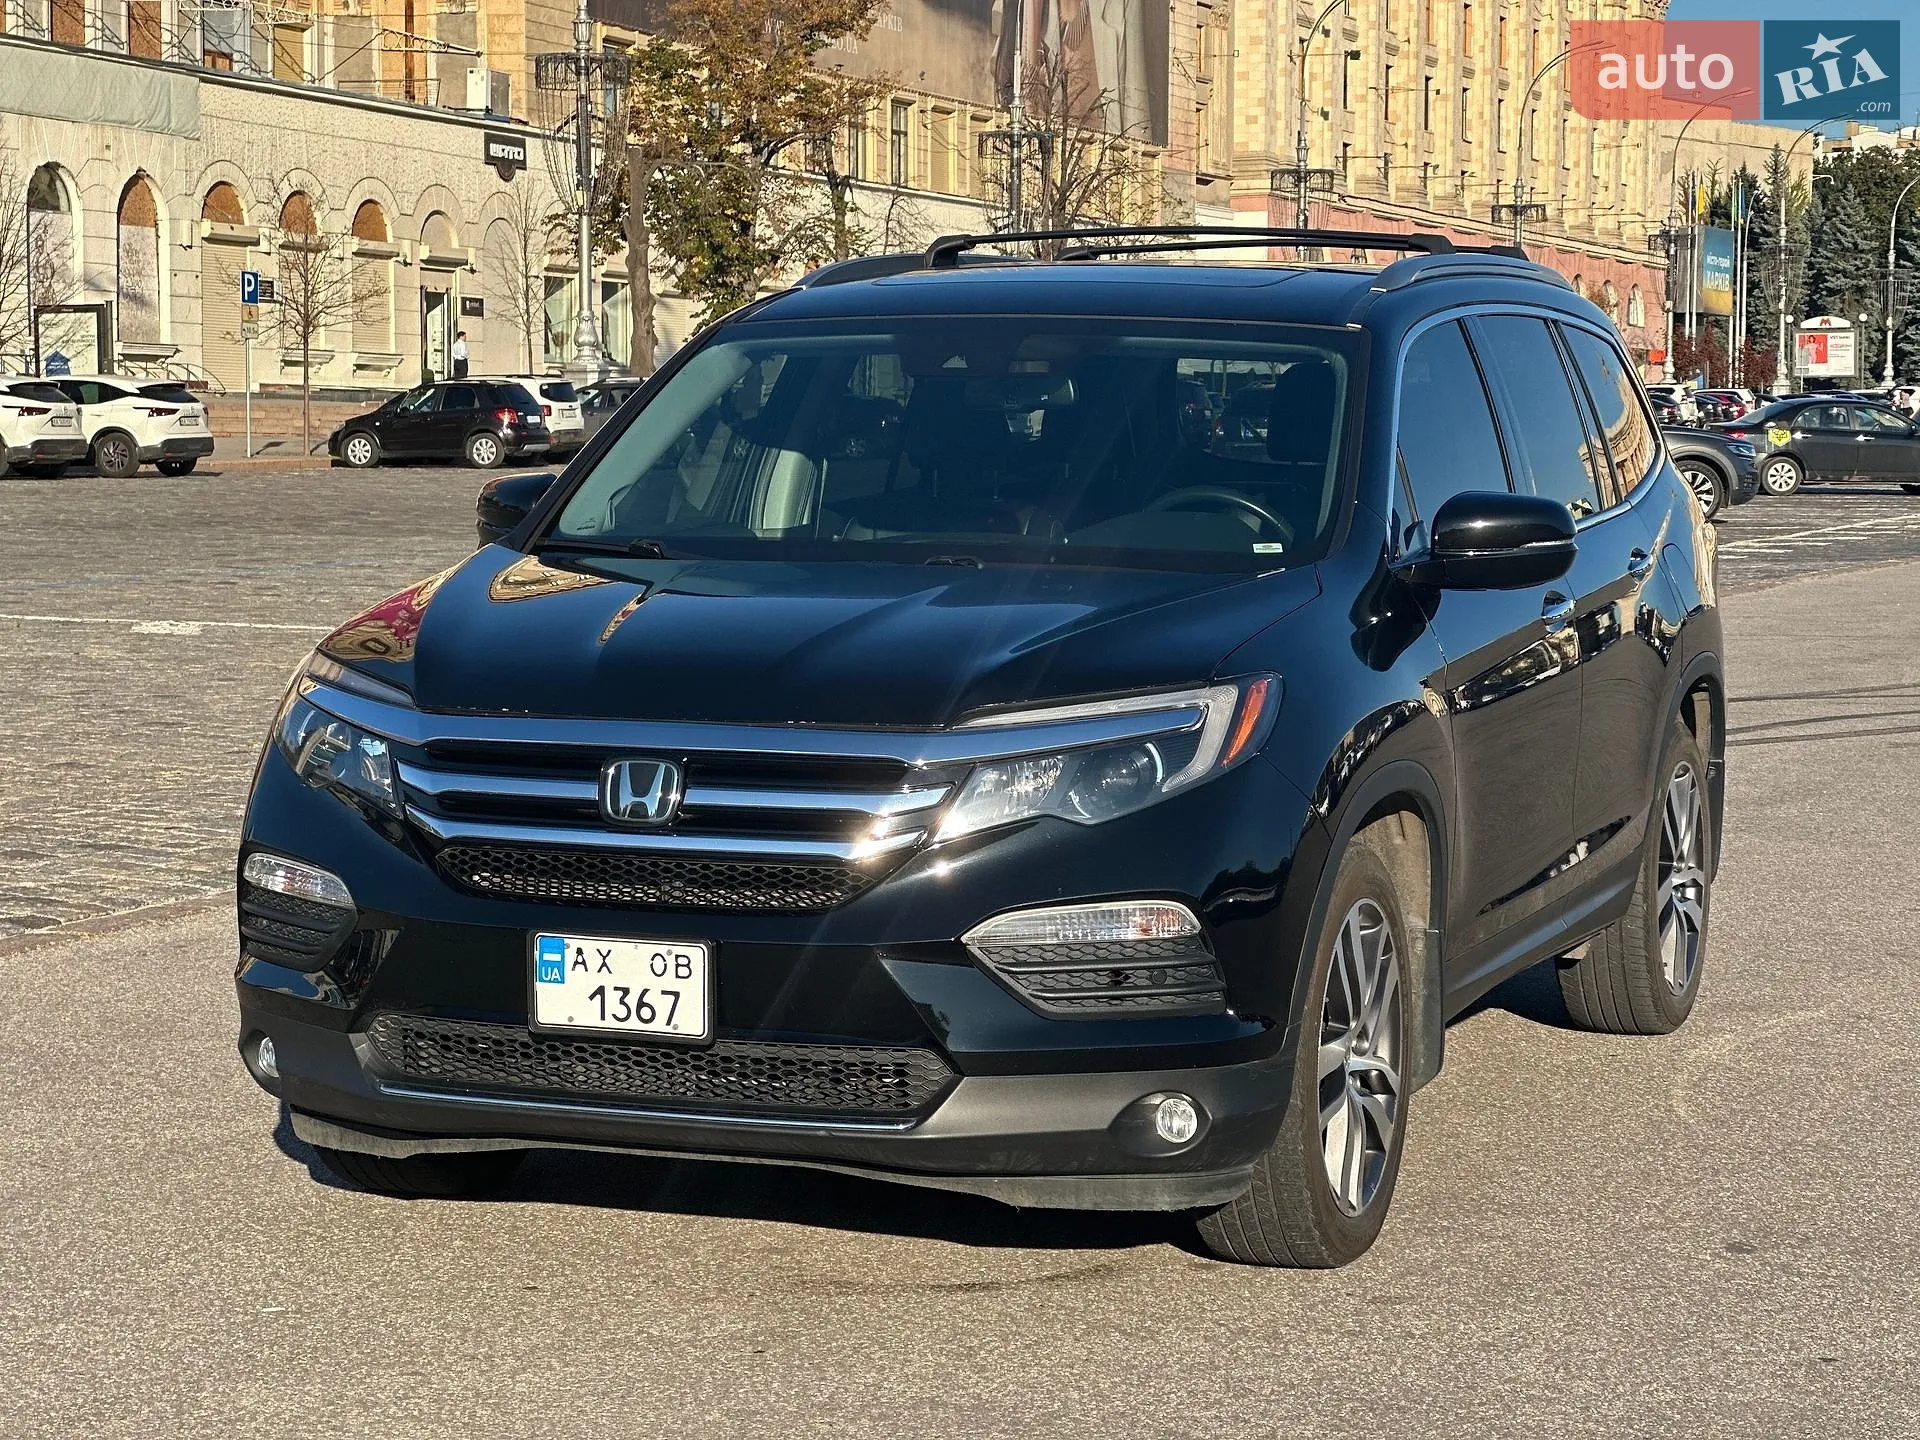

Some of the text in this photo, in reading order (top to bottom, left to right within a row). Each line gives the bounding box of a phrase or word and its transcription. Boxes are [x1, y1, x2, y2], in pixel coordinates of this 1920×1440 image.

[869, 12, 904, 32] АРКІВ
[244, 273, 255, 301] P
[541, 967, 562, 982] UA
[571, 947, 693, 979] AX OB
[588, 985, 681, 1026] 1367
